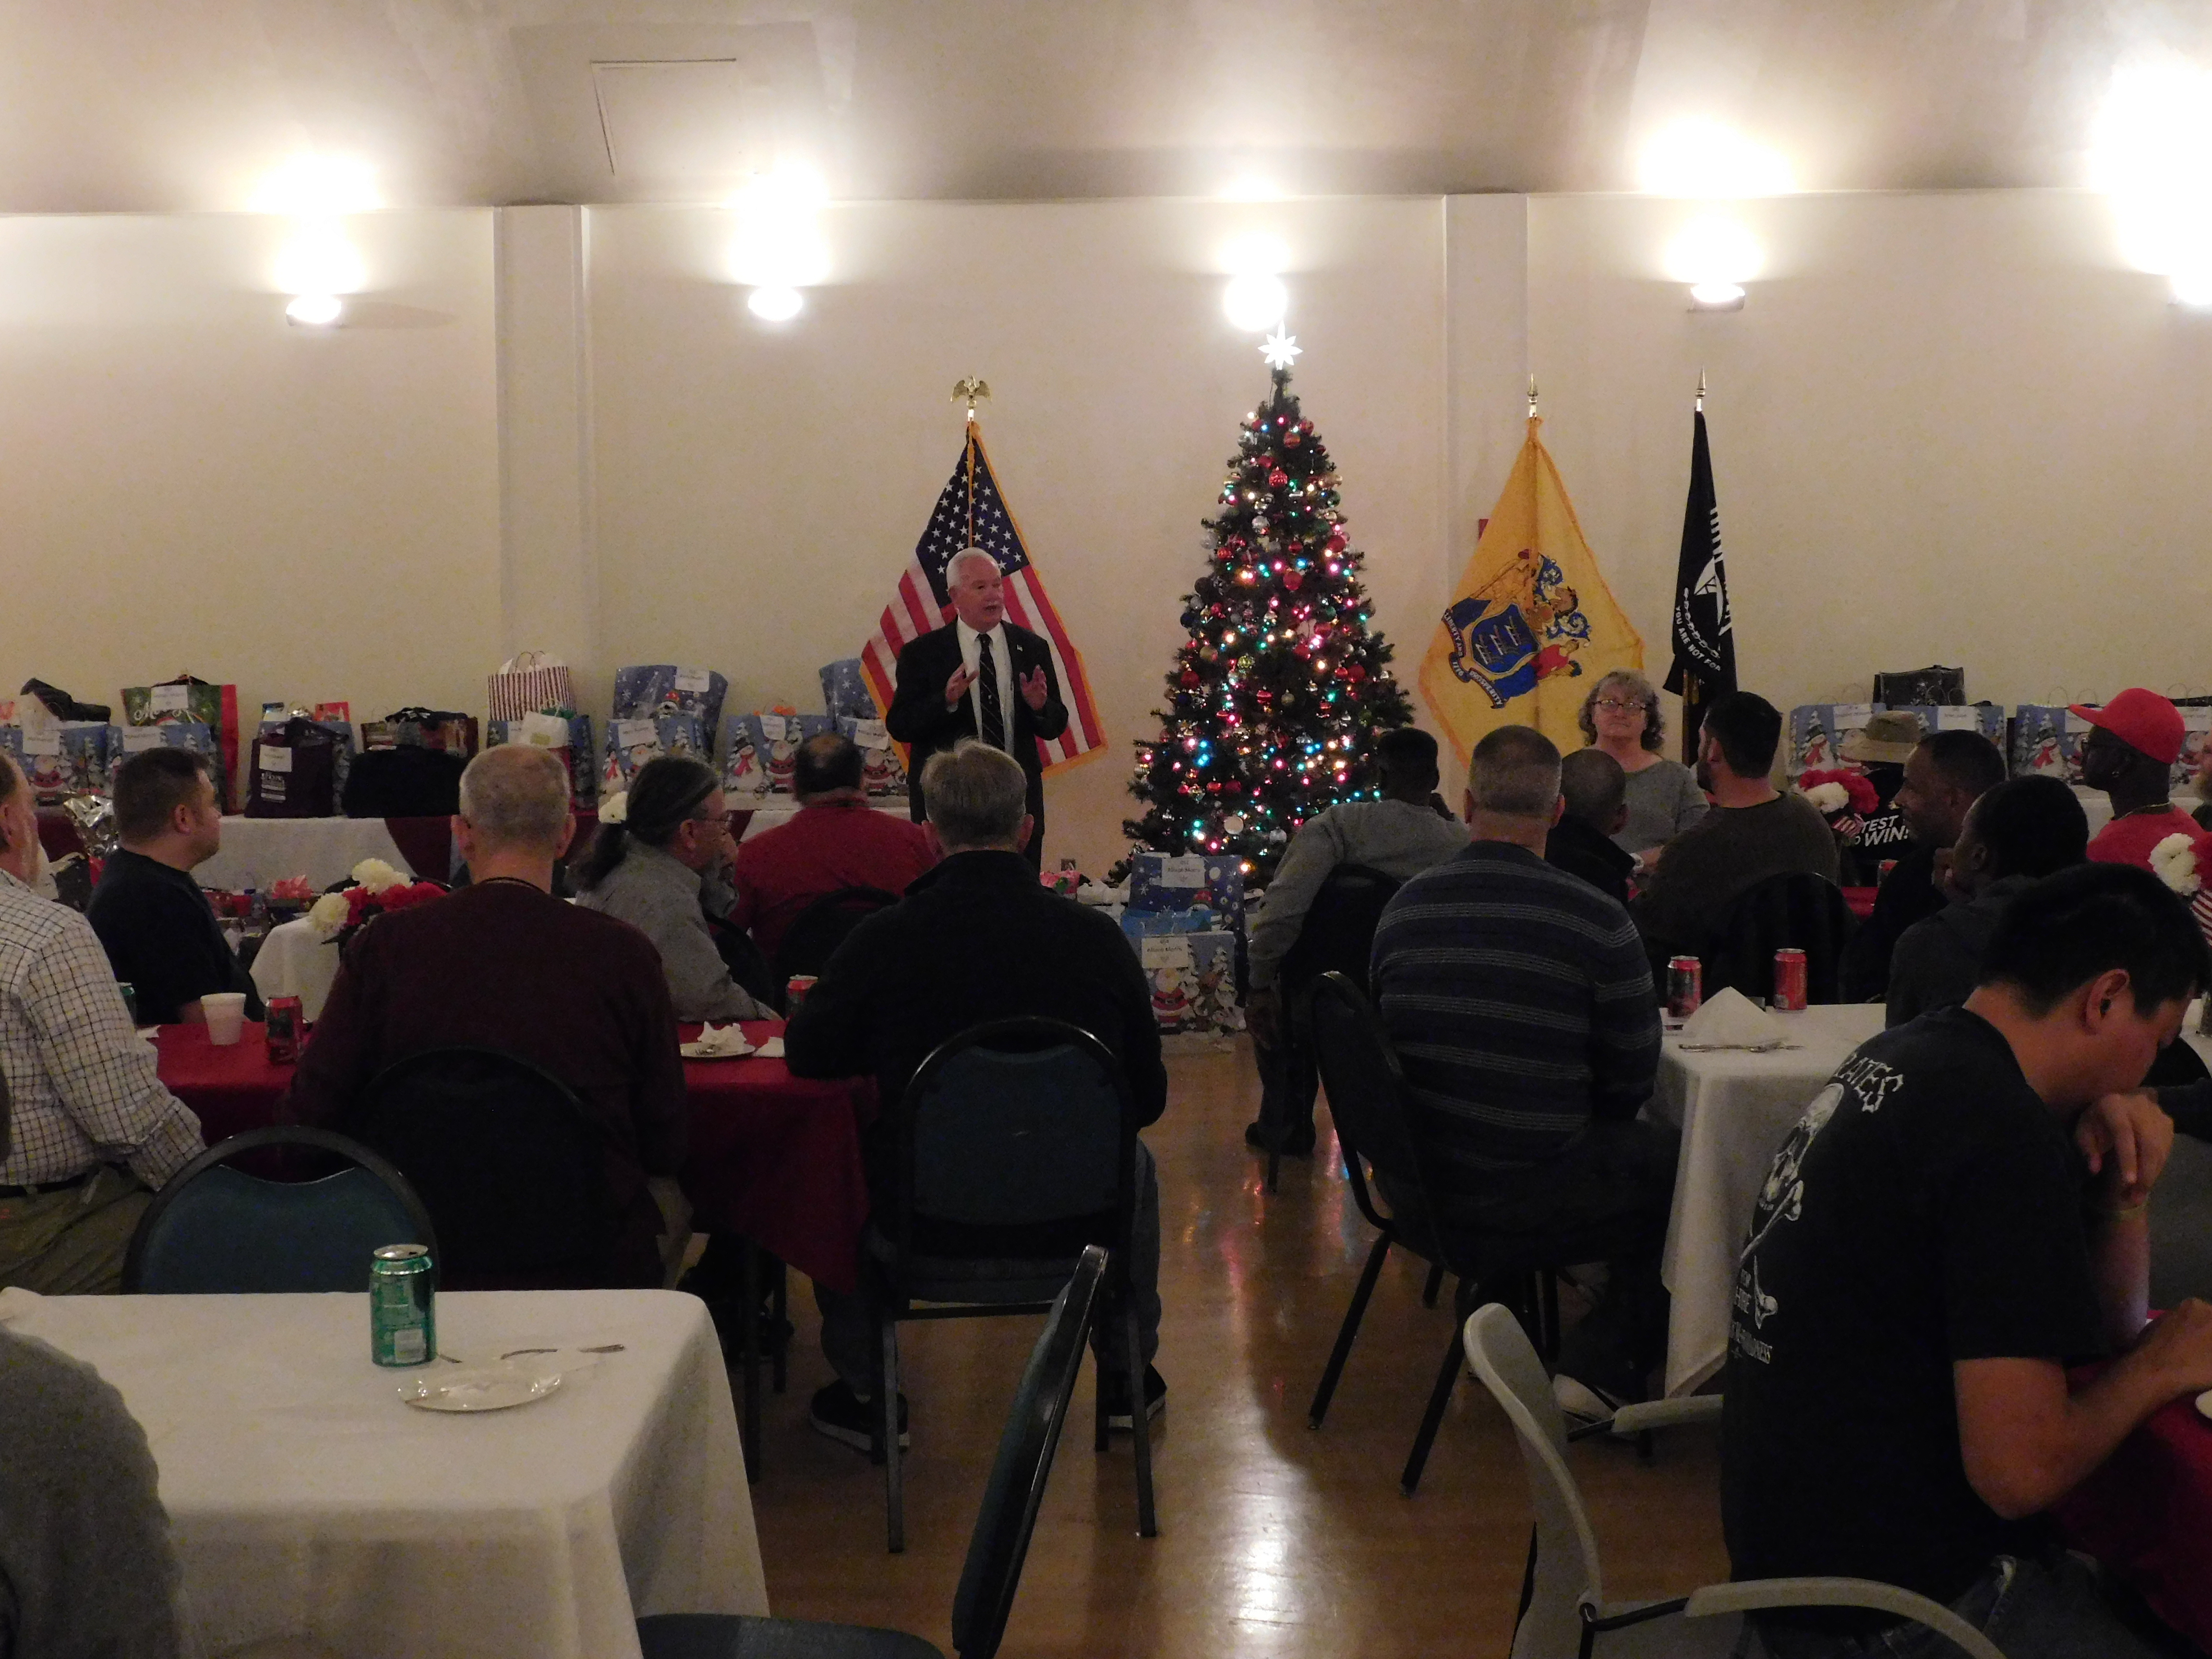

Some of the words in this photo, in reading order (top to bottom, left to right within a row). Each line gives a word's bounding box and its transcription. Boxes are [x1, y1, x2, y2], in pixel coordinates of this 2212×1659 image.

[1444, 612, 1461, 641] LIBERTY
[1678, 627, 1691, 644] ARE
[1688, 644, 1705, 659] NOT
[1452, 661, 1464, 676] 1776
[1469, 670, 1503, 705] PROSPERITY
[1864, 825, 1909, 847] WIN!
